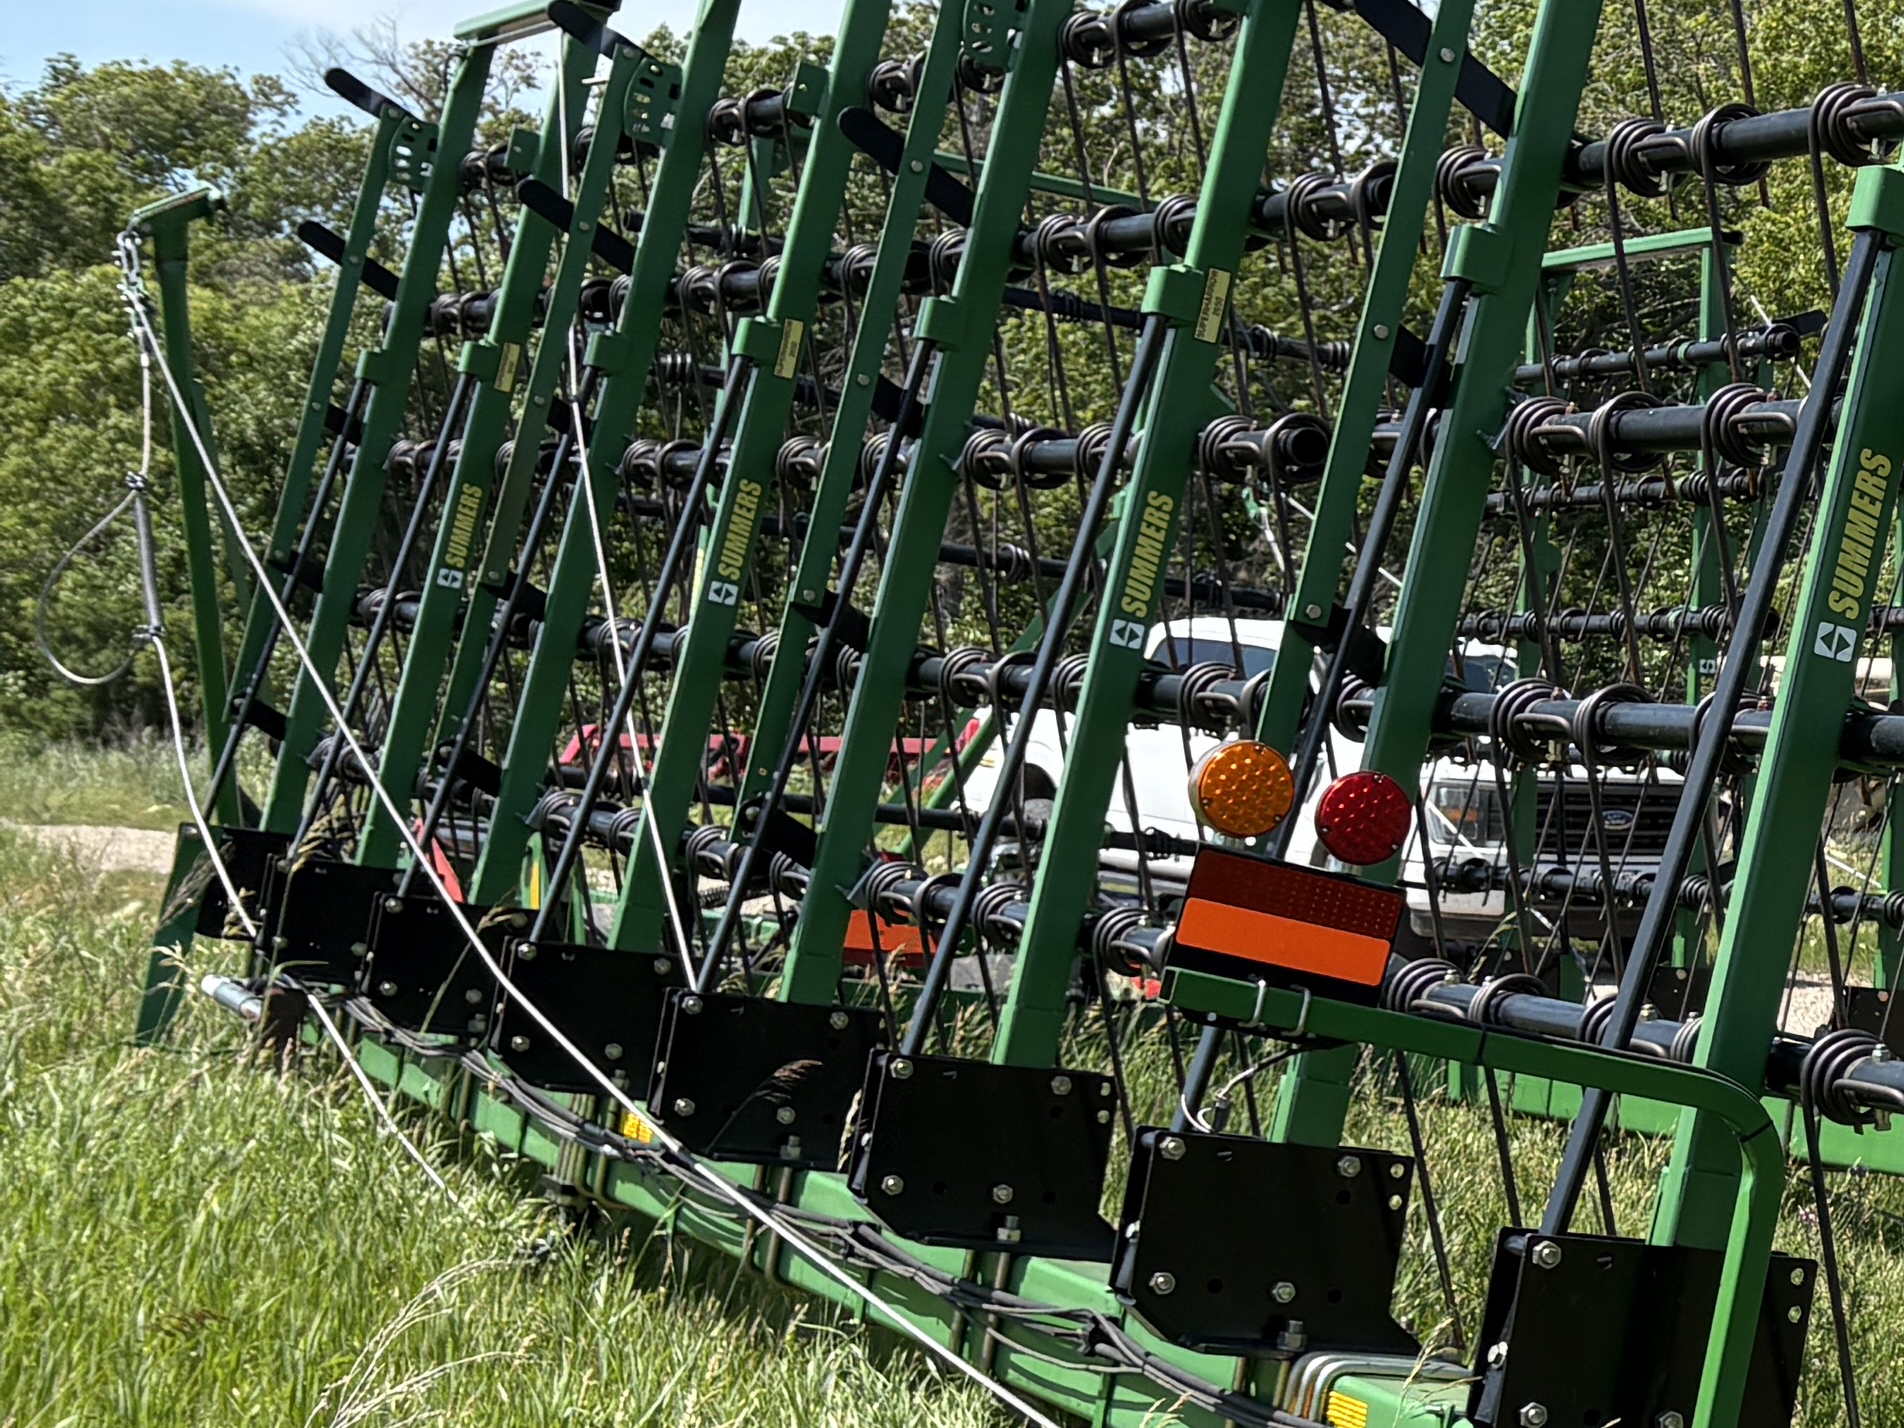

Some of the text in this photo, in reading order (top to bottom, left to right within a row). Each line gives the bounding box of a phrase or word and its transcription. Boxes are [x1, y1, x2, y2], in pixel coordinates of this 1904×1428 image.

[445, 483, 483, 568] SUMMERS
[718, 478, 762, 581] SUMMERS
[1121, 490, 1174, 618] SUMMERS
[1828, 448, 1892, 620] SUMMERS
